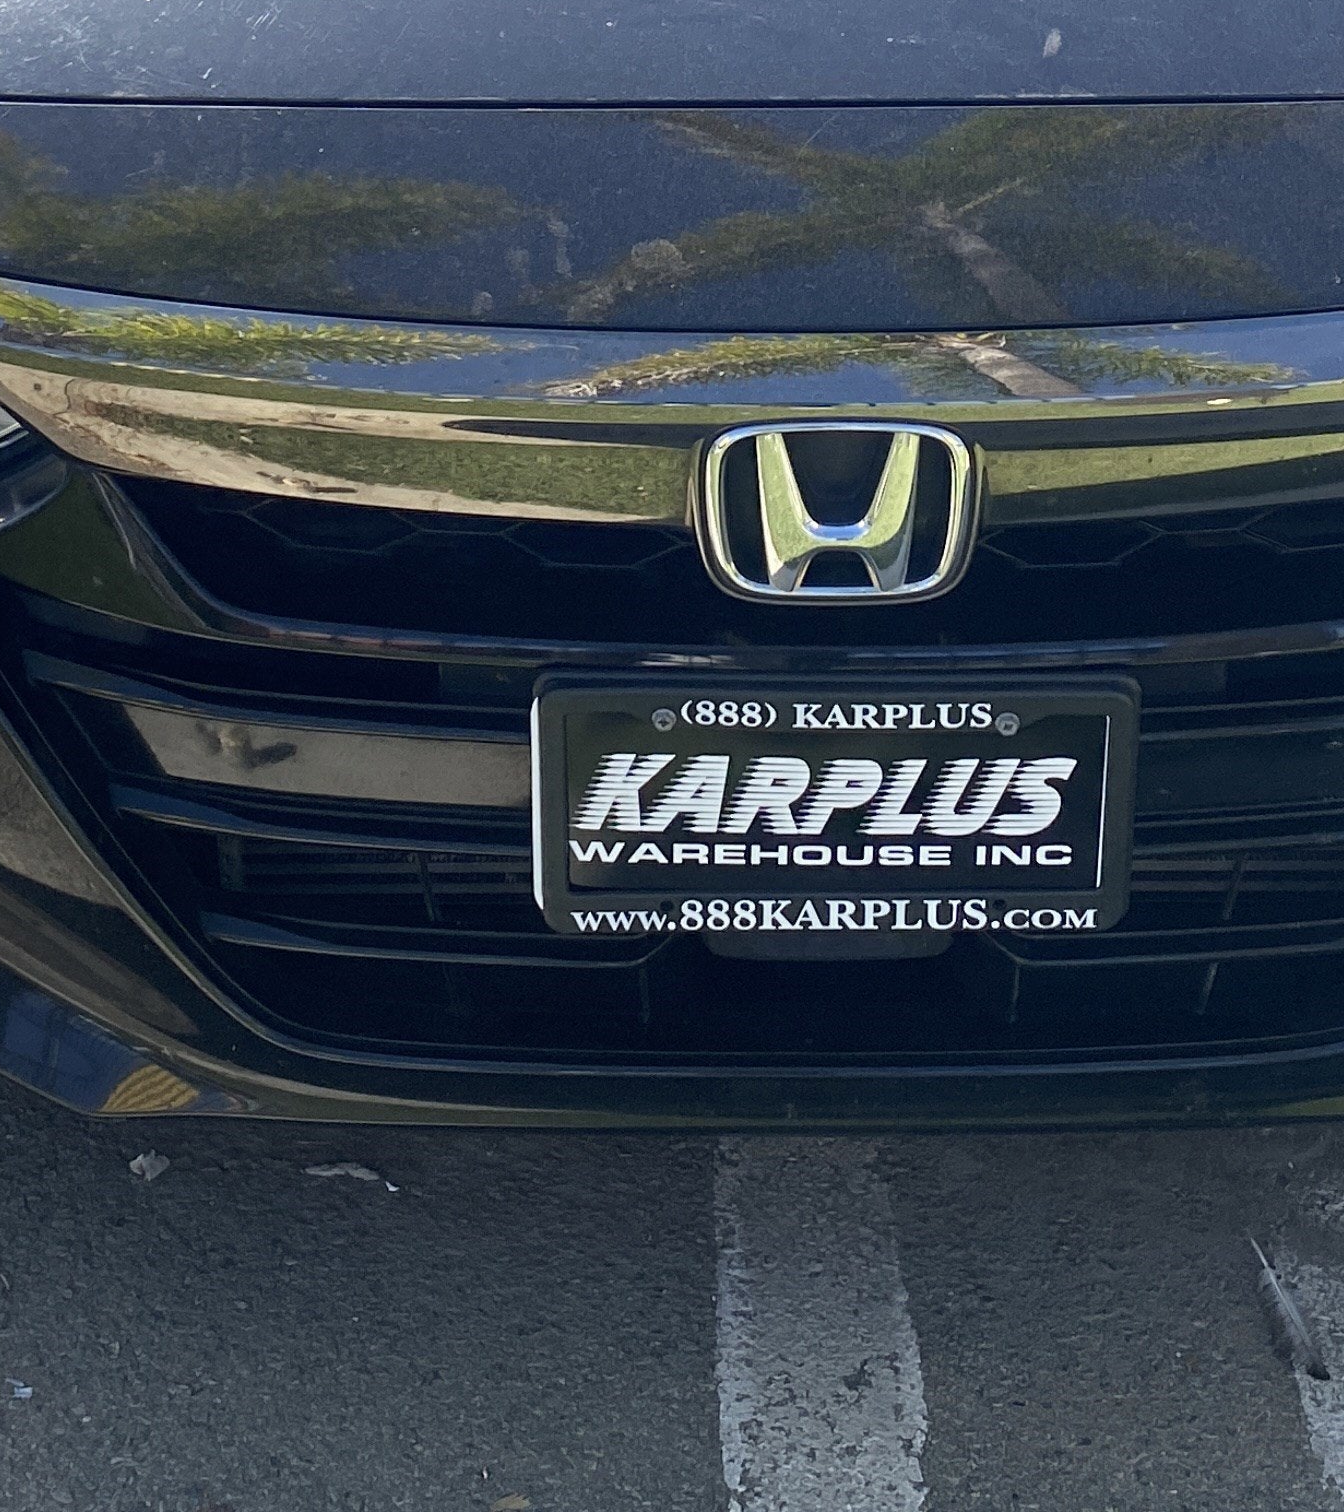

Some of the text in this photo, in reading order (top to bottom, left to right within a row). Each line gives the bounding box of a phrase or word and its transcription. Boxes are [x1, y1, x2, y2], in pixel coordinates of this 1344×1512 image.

[680, 699, 993, 730] (888) KARPLUS
[569, 753, 1078, 837] KARPLUS
[568, 841, 1073, 866] WAREHOUSE INC
